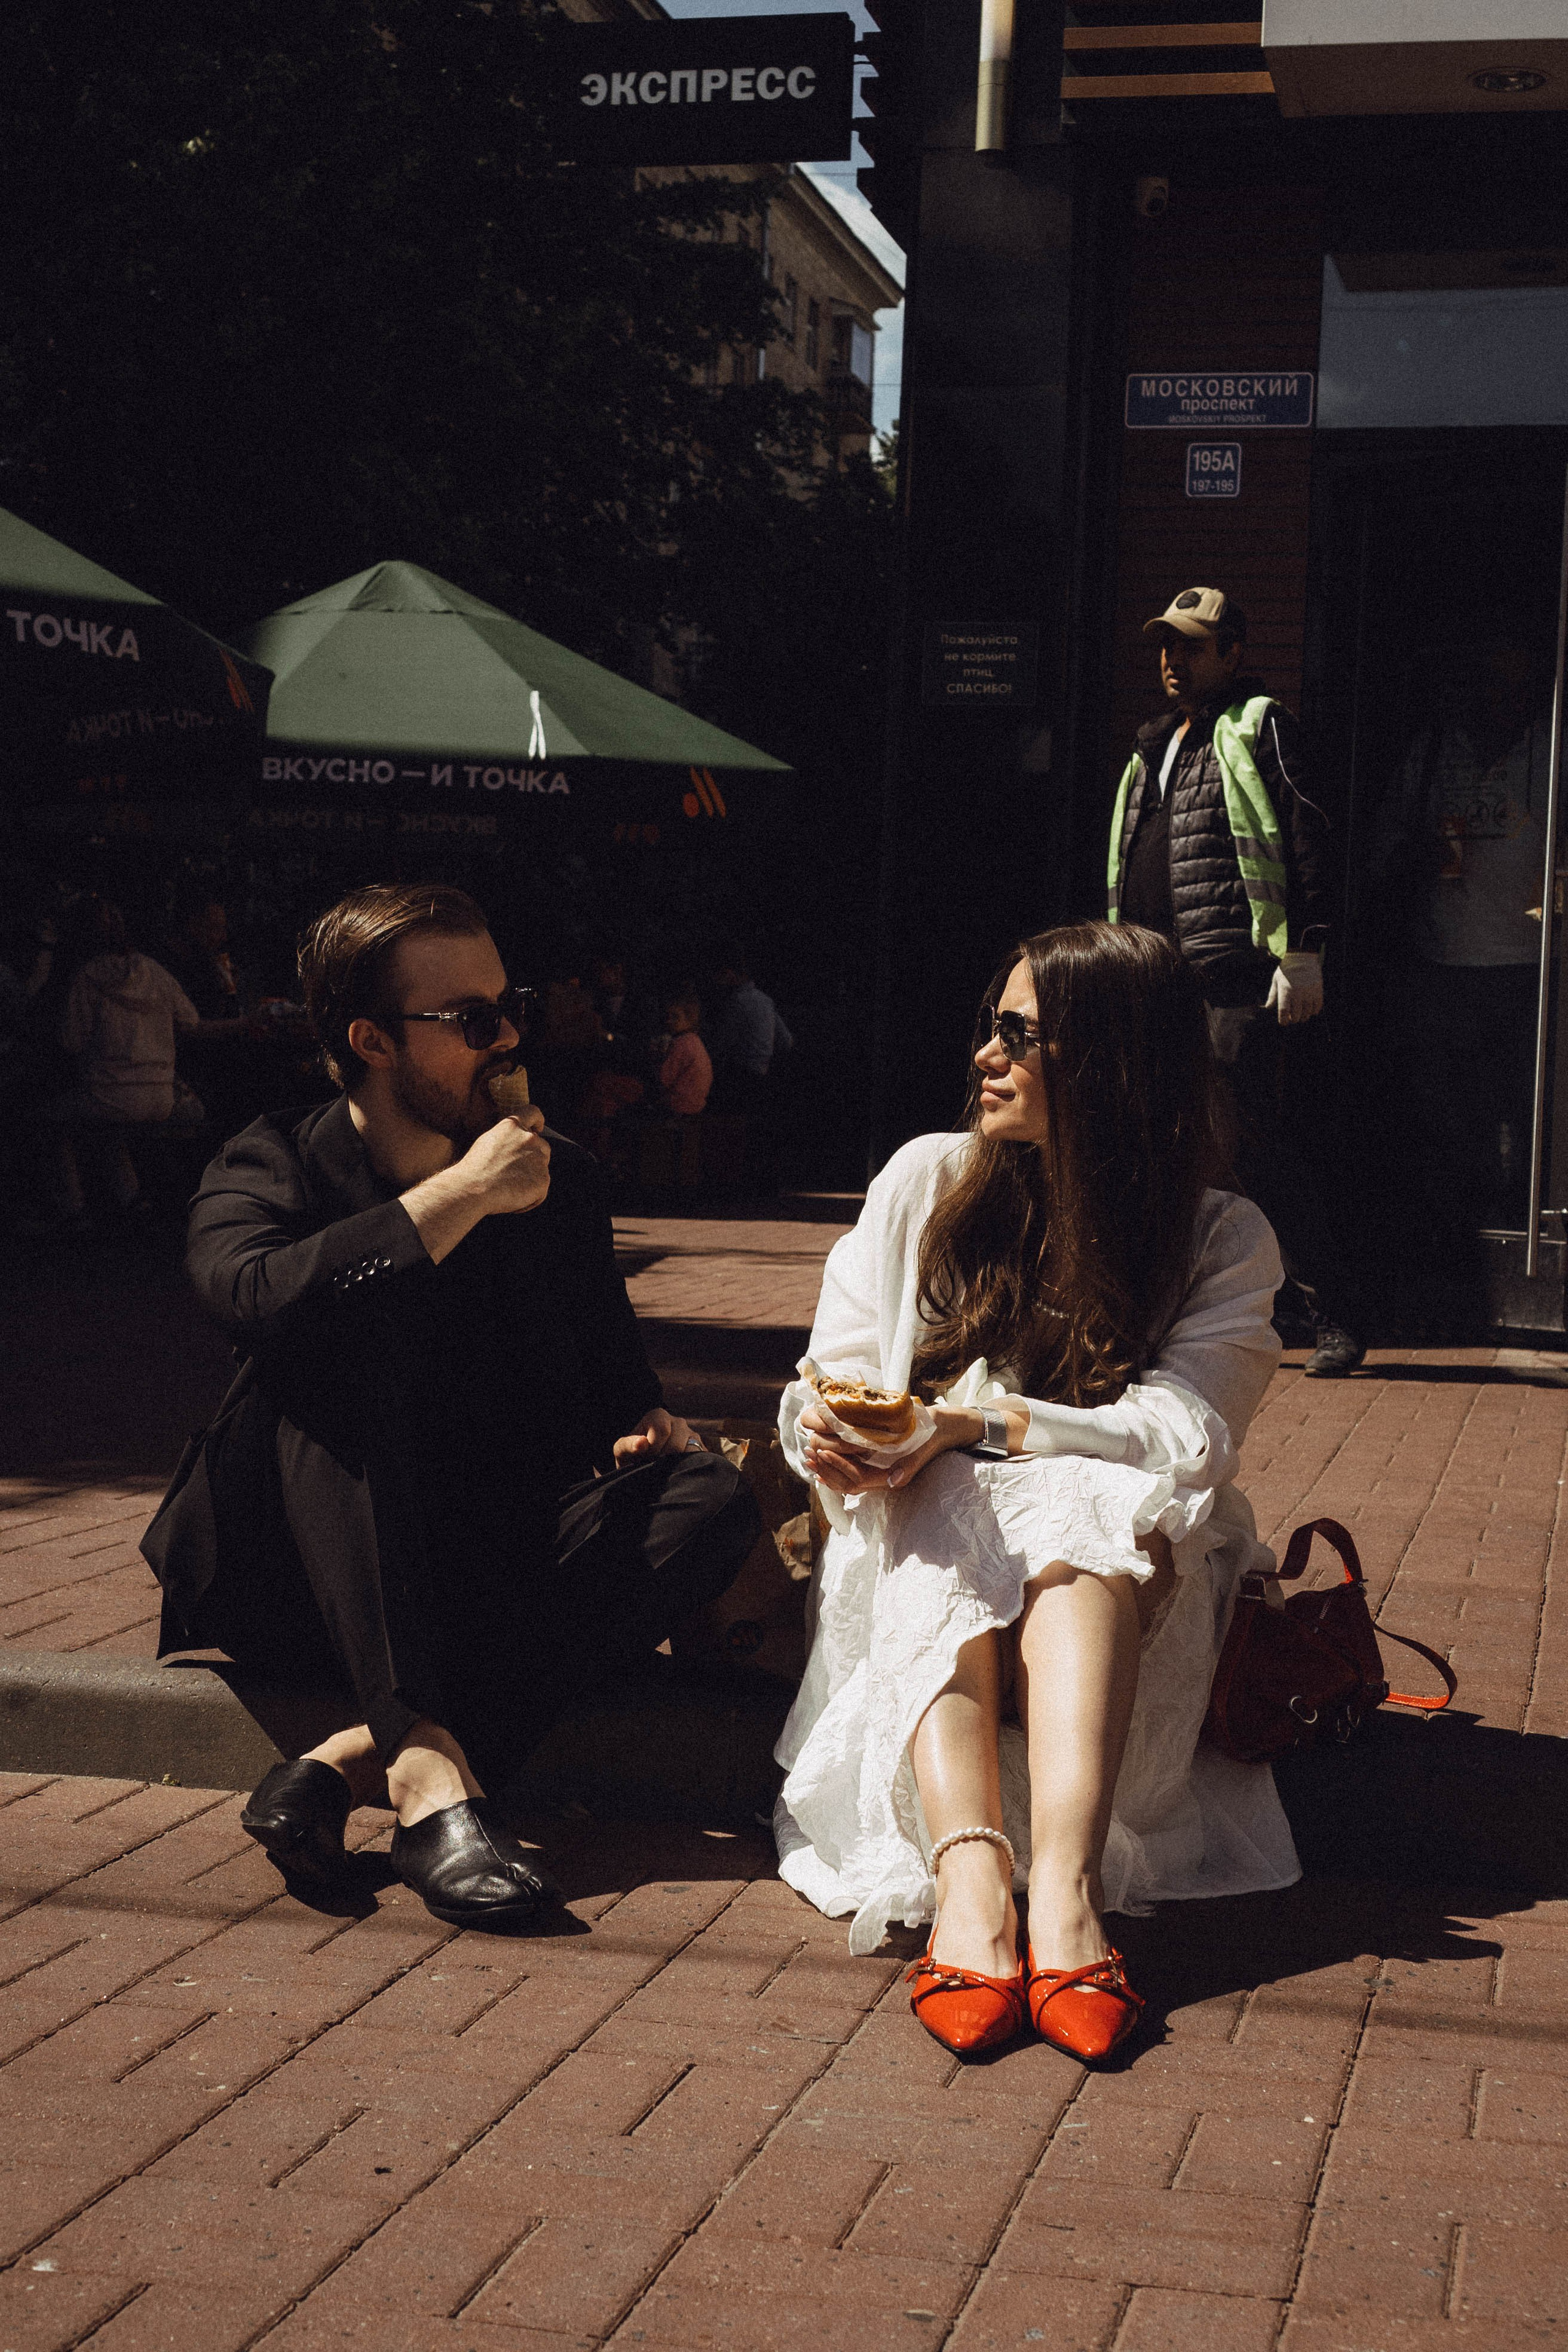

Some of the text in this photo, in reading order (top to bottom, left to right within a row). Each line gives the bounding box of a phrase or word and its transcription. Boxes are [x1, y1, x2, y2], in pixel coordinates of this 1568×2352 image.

[580, 66, 816, 106] ЭКСПРЕСС
[1141, 374, 1298, 397] МОСКОВСКИЙ
[1181, 398, 1256, 413] проспект
[1193, 450, 1235, 472] 195А
[1192, 480, 1234, 491] 197-195
[6, 609, 140, 662] ТОЧКА
[941, 633, 1019, 646] Пожалуйста
[944, 652, 1017, 663] не кормите
[262, 756, 396, 785] ВКУСНО
[462, 765, 571, 794] ТОЧКА
